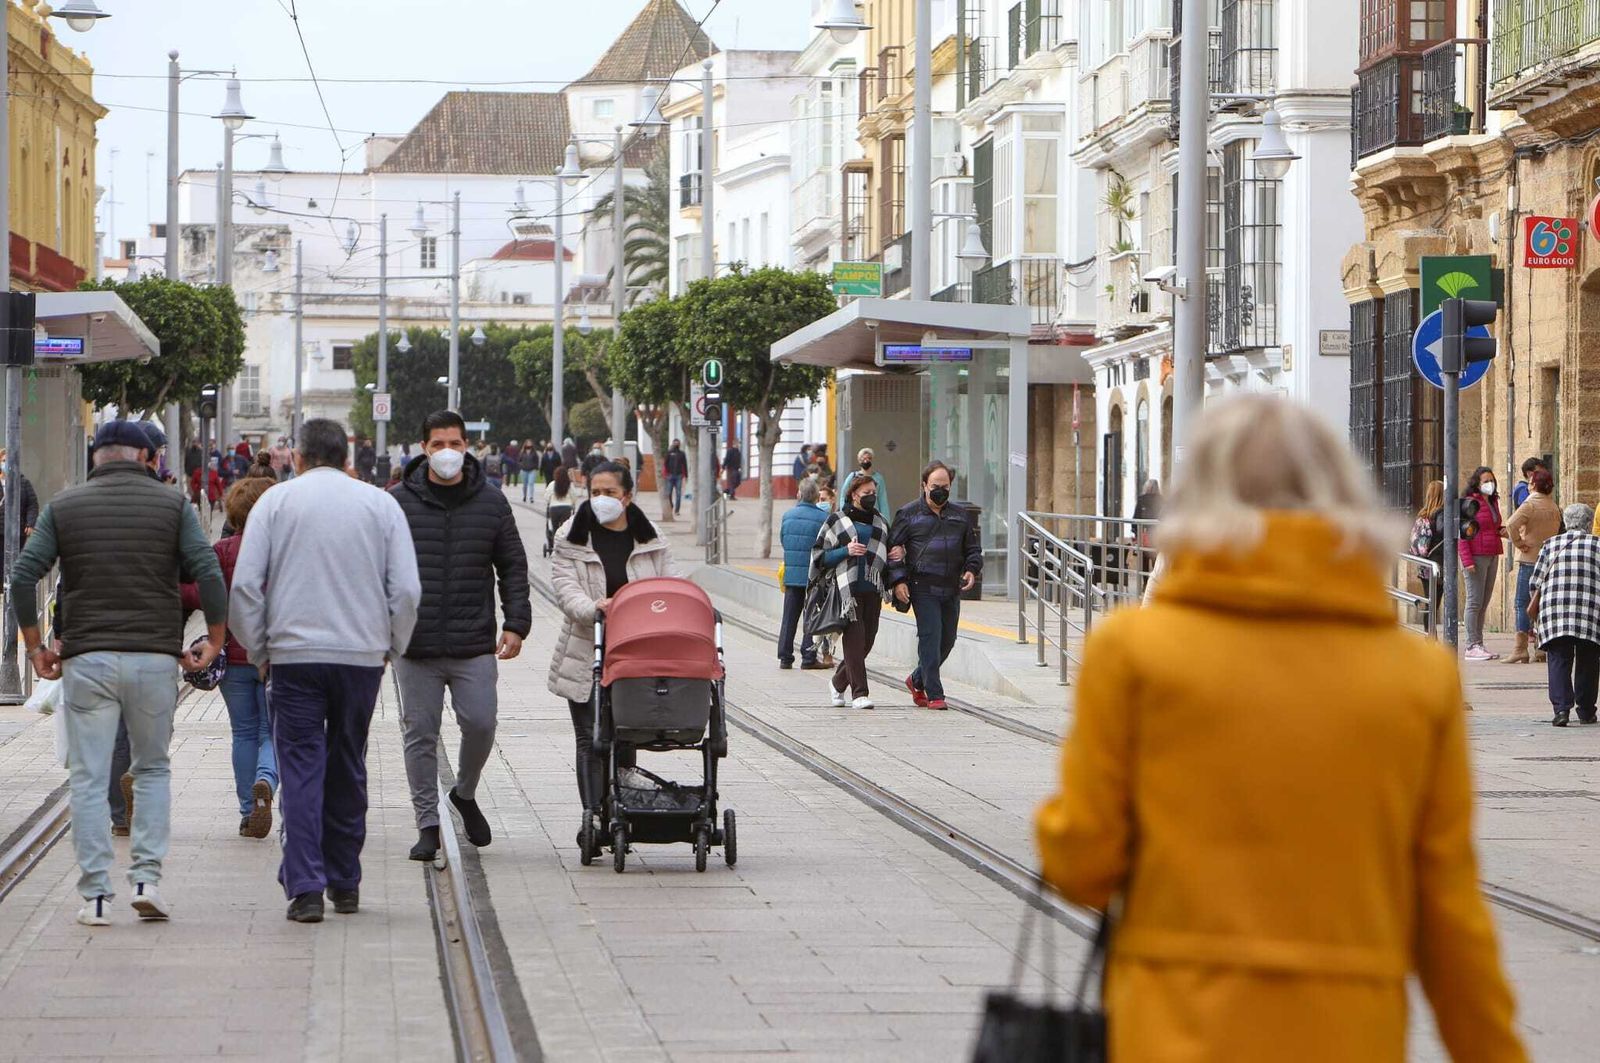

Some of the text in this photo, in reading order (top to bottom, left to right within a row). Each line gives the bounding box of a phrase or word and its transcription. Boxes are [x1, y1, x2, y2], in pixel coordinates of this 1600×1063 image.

[1528, 257, 1574, 265] EURO 6000
[834, 271, 880, 281] CAMPOS
